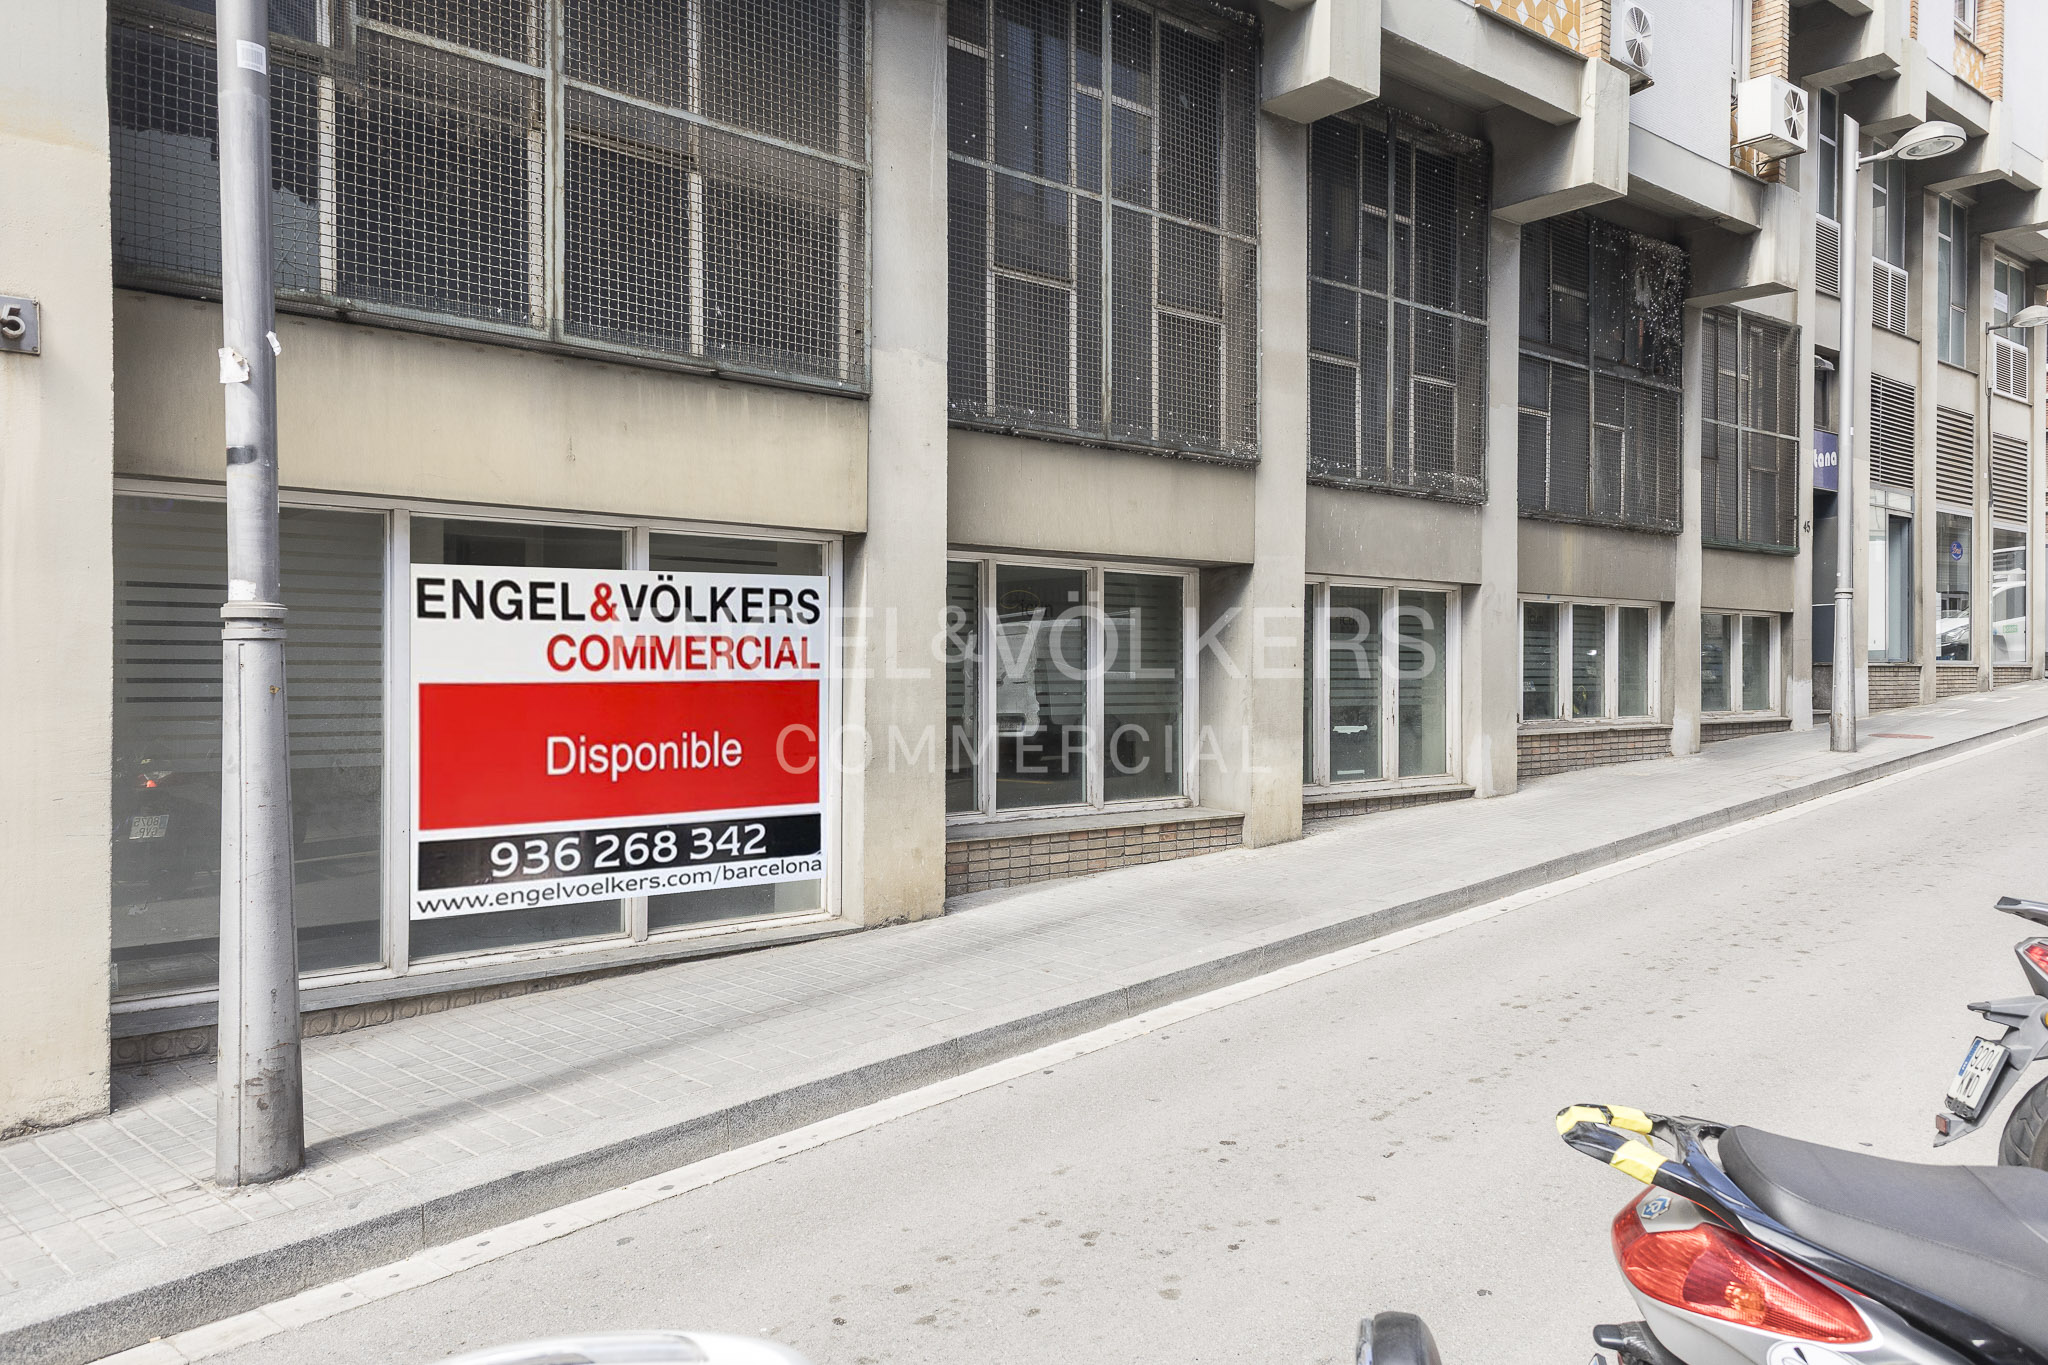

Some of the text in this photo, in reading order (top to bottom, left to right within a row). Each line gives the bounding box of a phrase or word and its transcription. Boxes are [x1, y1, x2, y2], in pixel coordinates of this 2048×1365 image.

[1803, 521, 1811, 533] 45
[416, 574, 820, 624] ENGEL&VÖLKERS
[546, 633, 820, 672] COMMERCIAL
[546, 731, 743, 782] Disponible
[490, 823, 767, 878] 936 268 342
[417, 857, 823, 914] www.engelvoelkers.com/barcelona
